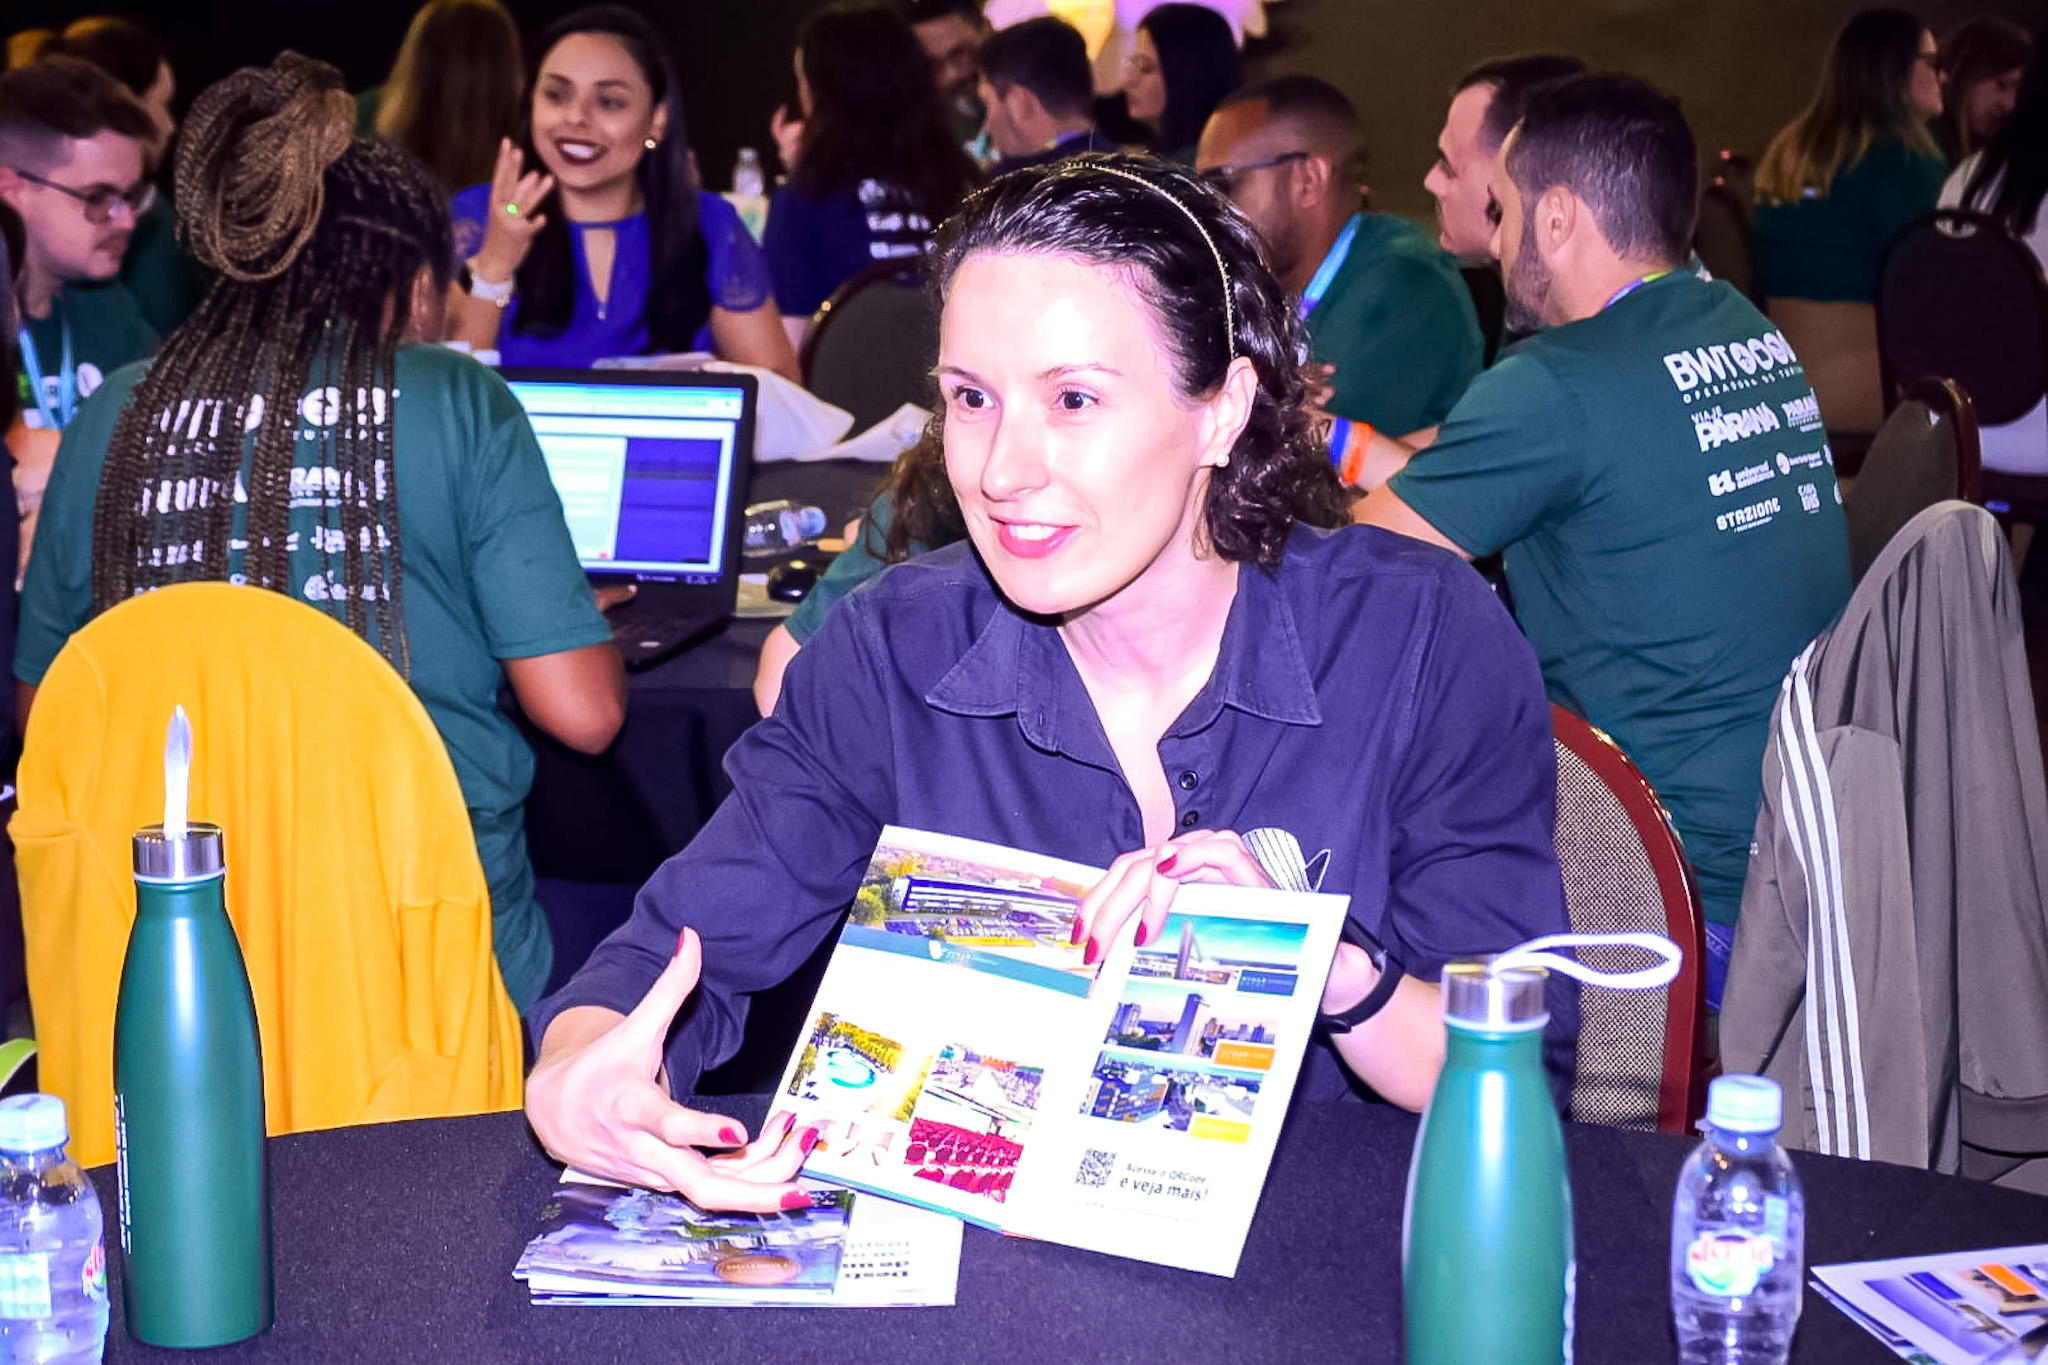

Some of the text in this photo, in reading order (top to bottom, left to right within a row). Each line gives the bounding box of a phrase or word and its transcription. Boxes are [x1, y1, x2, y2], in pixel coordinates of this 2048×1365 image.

[1119, 1176, 1209, 1201] e veja mais!
